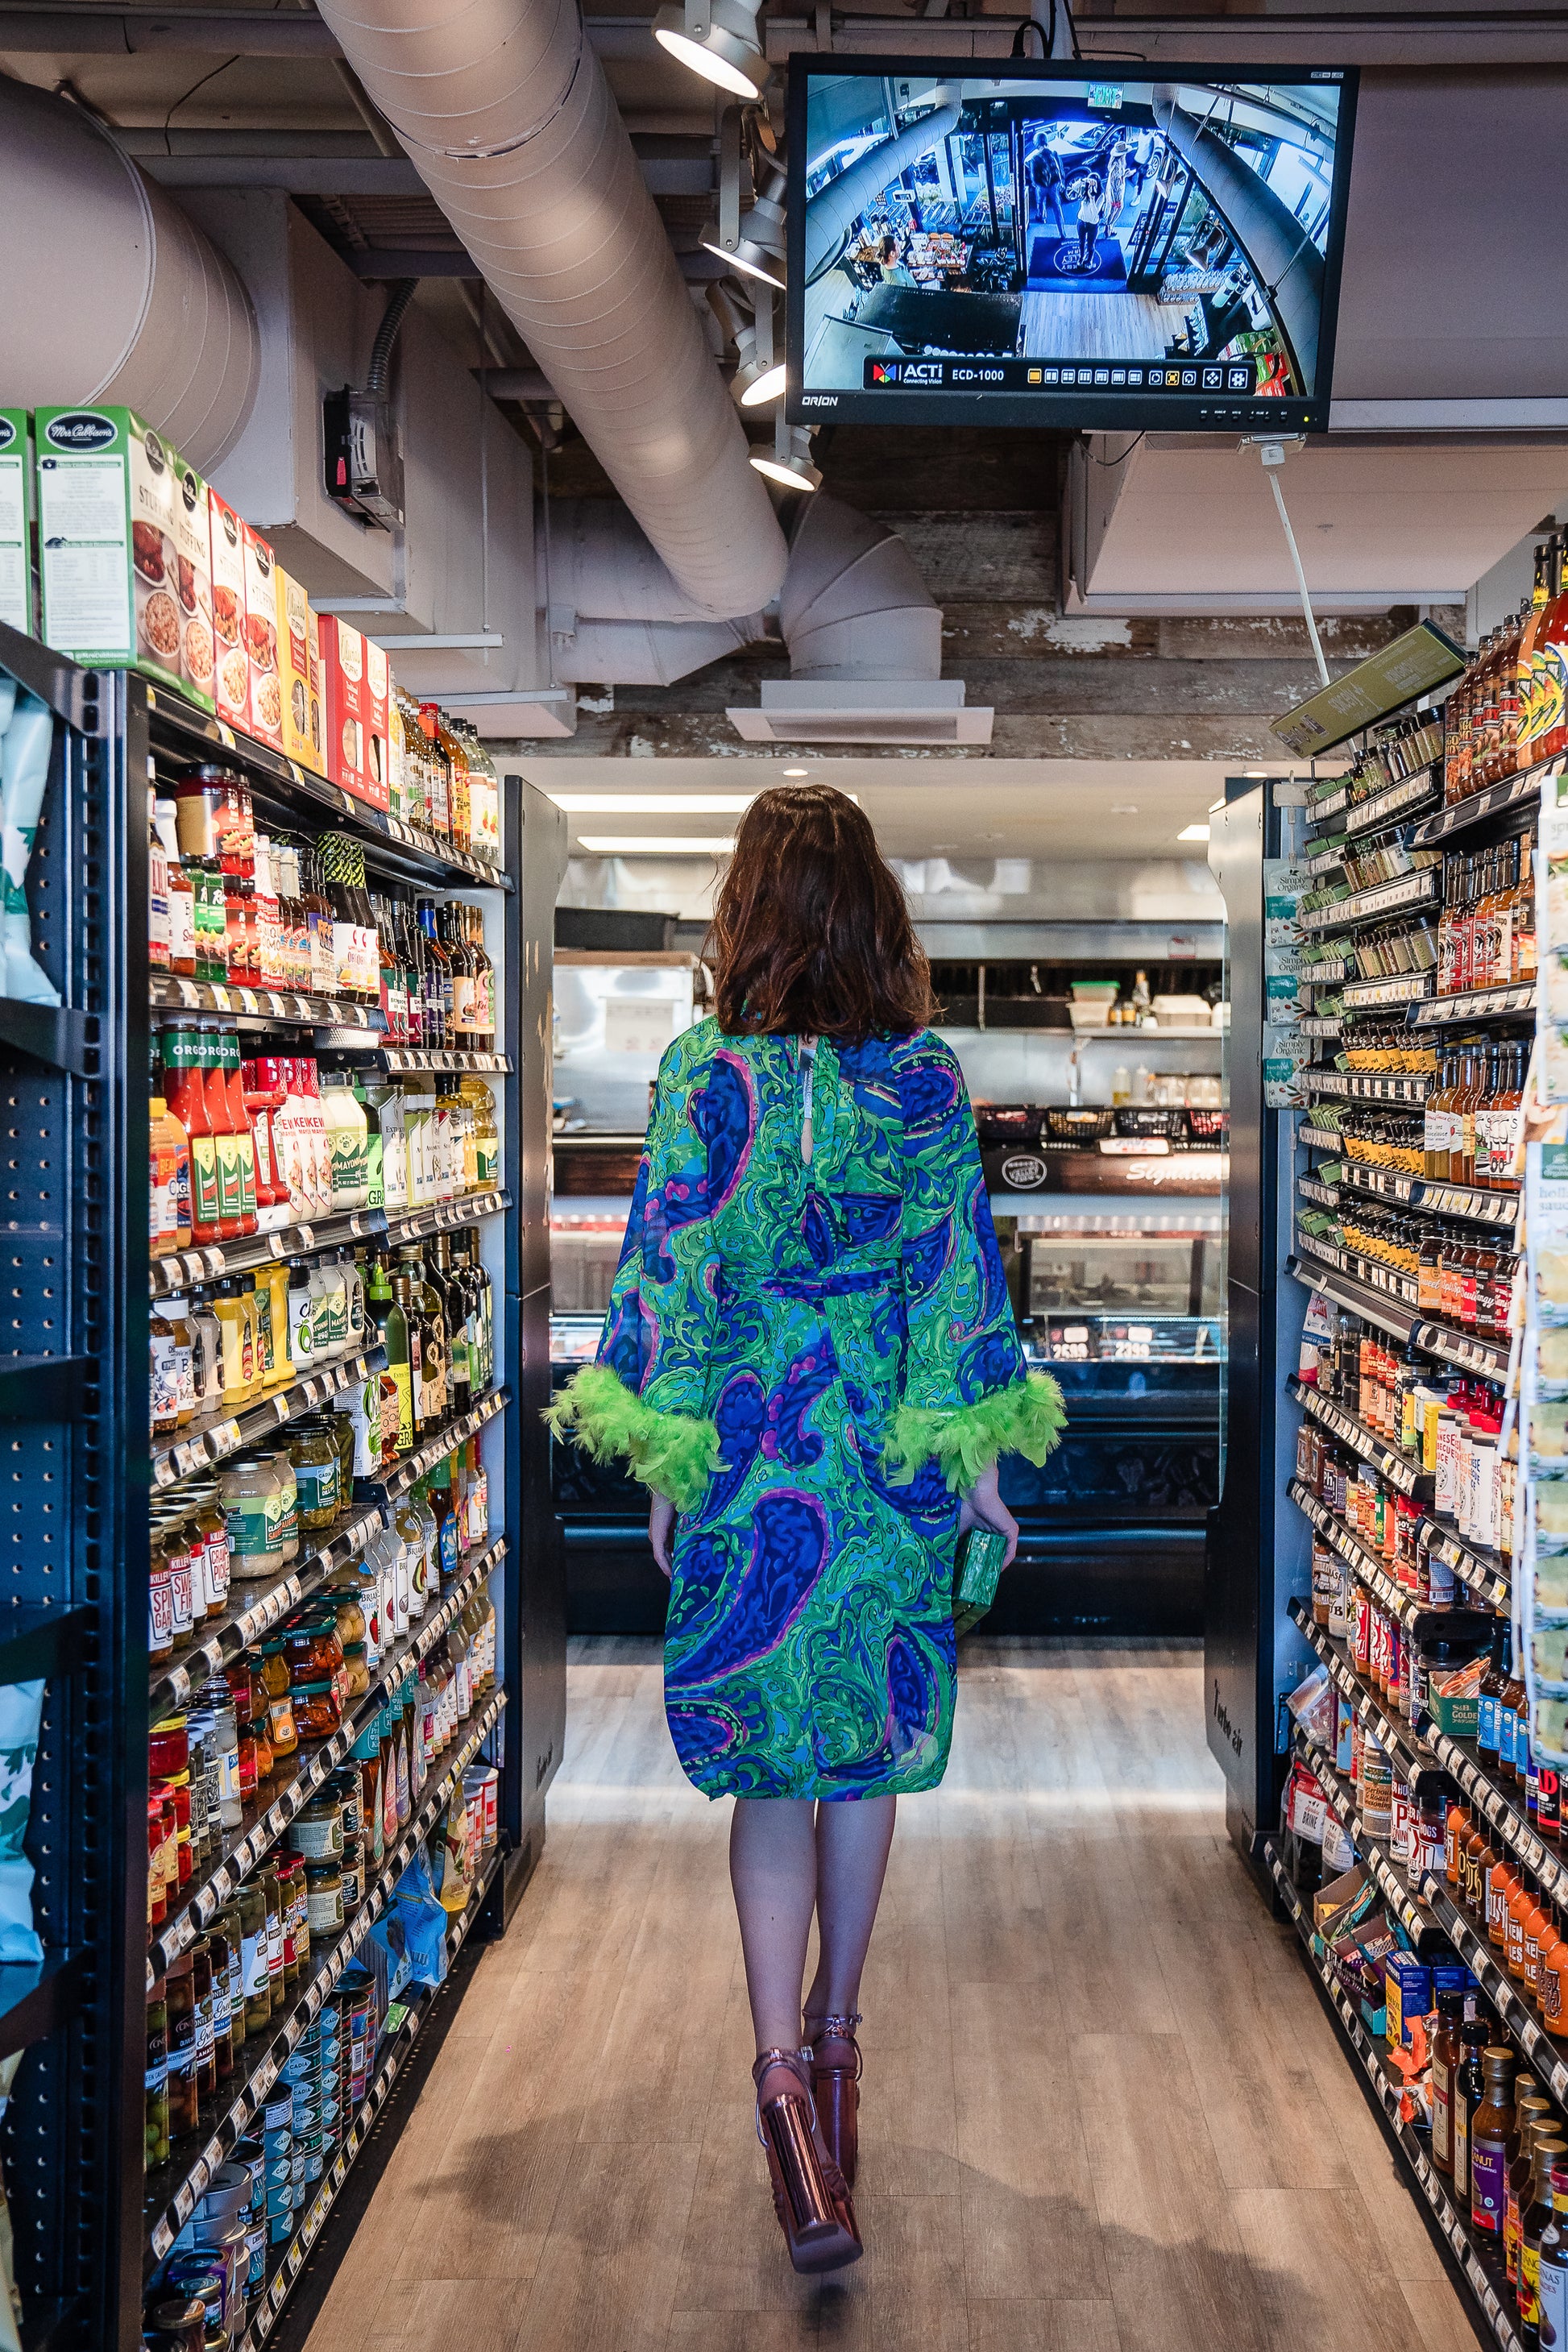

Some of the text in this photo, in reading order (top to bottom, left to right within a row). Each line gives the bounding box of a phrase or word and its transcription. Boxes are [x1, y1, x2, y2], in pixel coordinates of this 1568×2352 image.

[904, 363, 943, 377] ACTi
[952, 369, 1004, 380] ECD-1000
[802, 396, 839, 406] ORION
[1280, 876, 1305, 886] Simply
[1277, 884, 1309, 893] Organic
[1281, 956, 1304, 966] Simpl
[1279, 964, 1303, 973] Organ
[1278, 1040, 1305, 1050] Simply
[1276, 1047, 1306, 1056] Organic
[1126, 1162, 1222, 1184] Signatur
[1301, 1811, 1318, 1830] BRINE
[214, 2000, 230, 2019] Gree
[197, 2028, 214, 2047] Gree
[289, 2060, 309, 2069] CADIA
[293, 2086, 311, 2096] CADIA
[296, 2113, 313, 2123] CADIA
